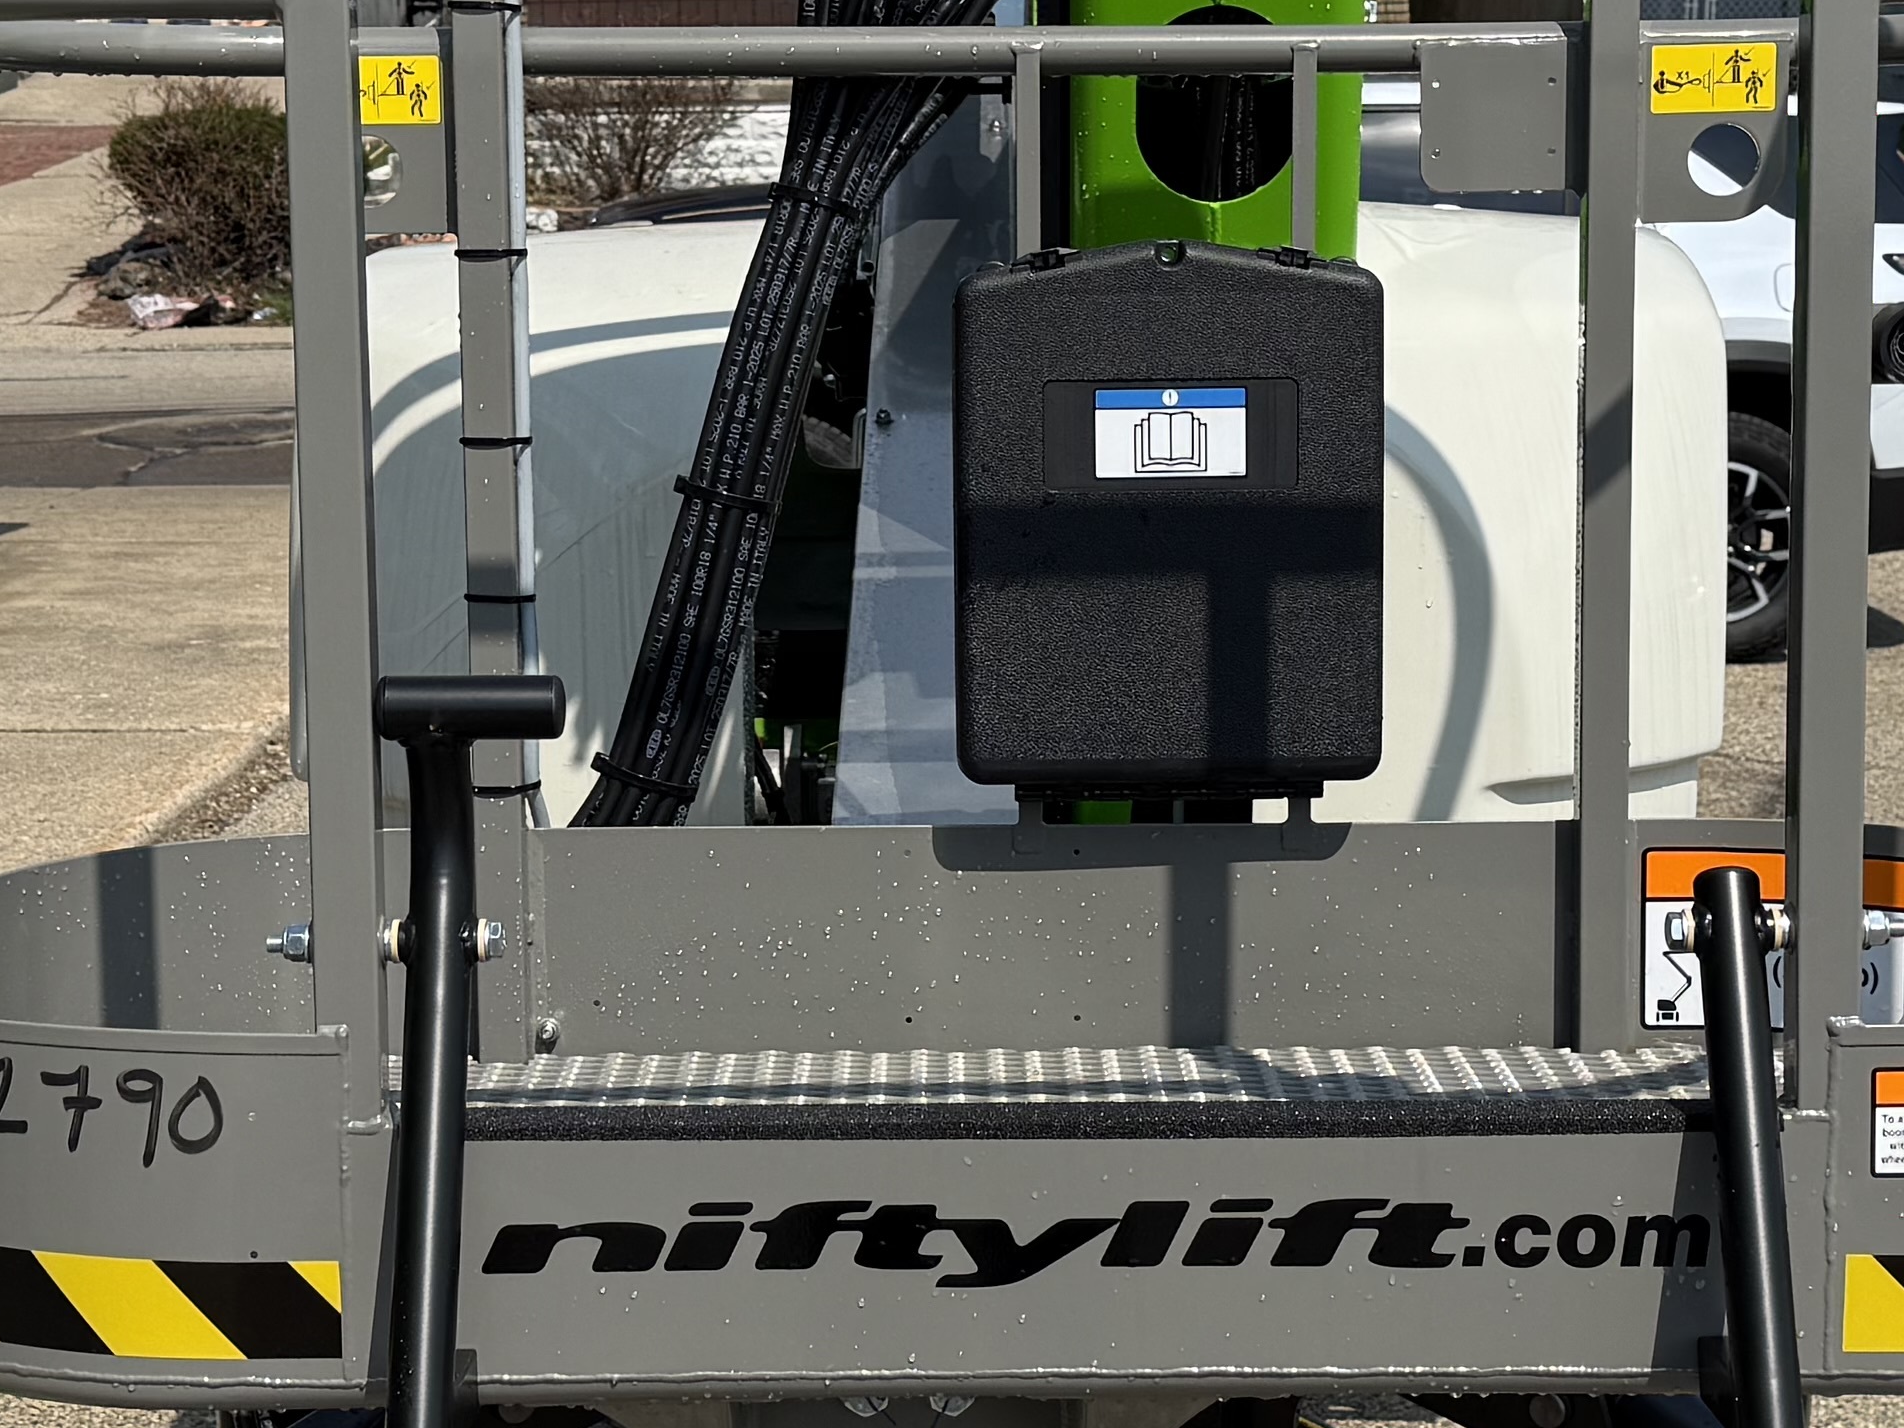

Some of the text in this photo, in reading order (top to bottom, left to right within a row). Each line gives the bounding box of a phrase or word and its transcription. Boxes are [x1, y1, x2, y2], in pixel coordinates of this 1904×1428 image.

[811, 157, 828, 175] IN
[741, 339, 765, 386] 1-2025
[733, 392, 750, 418] BAR
[735, 535, 754, 562] SAE
[688, 549, 714, 596] 100R18
[681, 601, 699, 628] SAE
[1881, 1114, 1894, 1123] To
[482, 1199, 1711, 1289] niftylift.com
